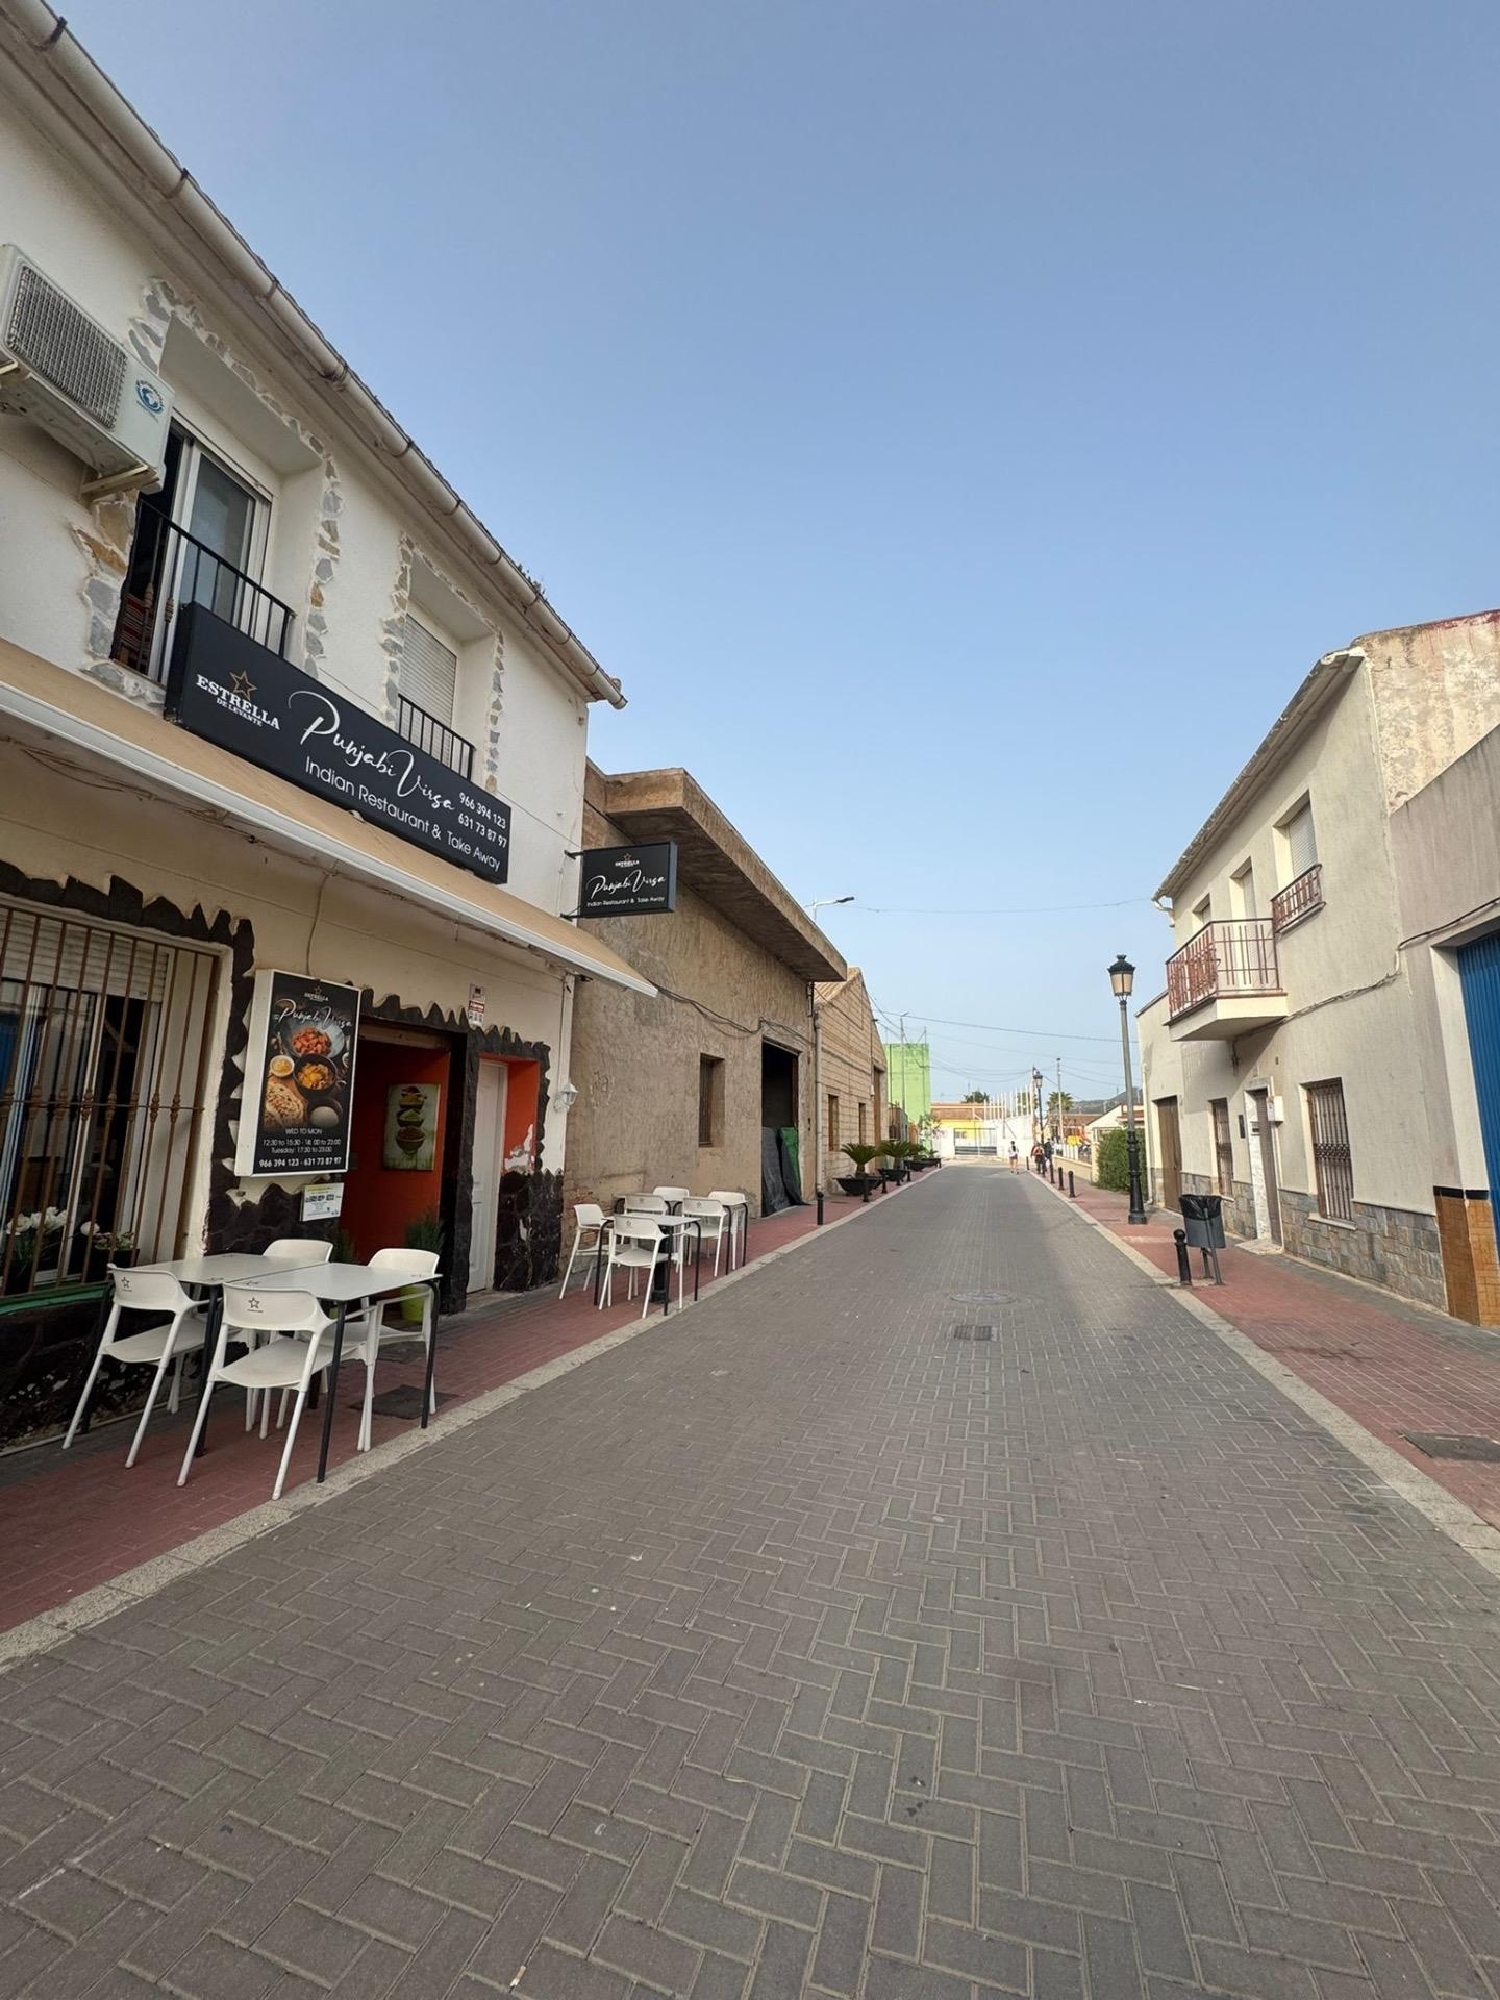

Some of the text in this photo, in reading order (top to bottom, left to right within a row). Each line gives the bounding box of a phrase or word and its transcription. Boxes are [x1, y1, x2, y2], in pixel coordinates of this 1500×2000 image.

[196, 674, 280, 730] ESTRELLA
[216, 697, 263, 727] DE LEVANTE
[288, 690, 396, 777] Punjabi
[305, 755, 500, 872] Indian Restaurant & Take Away
[459, 792, 506, 829] 966 394 123
[458, 813, 507, 848] 631 73 87 97
[585, 875, 631, 900] Punjabi
[274, 998, 320, 1024] Punjabi
[299, 1127, 307, 1135] TO
[273, 1158, 286, 1167] 394
[288, 1158, 300, 1167] 123
